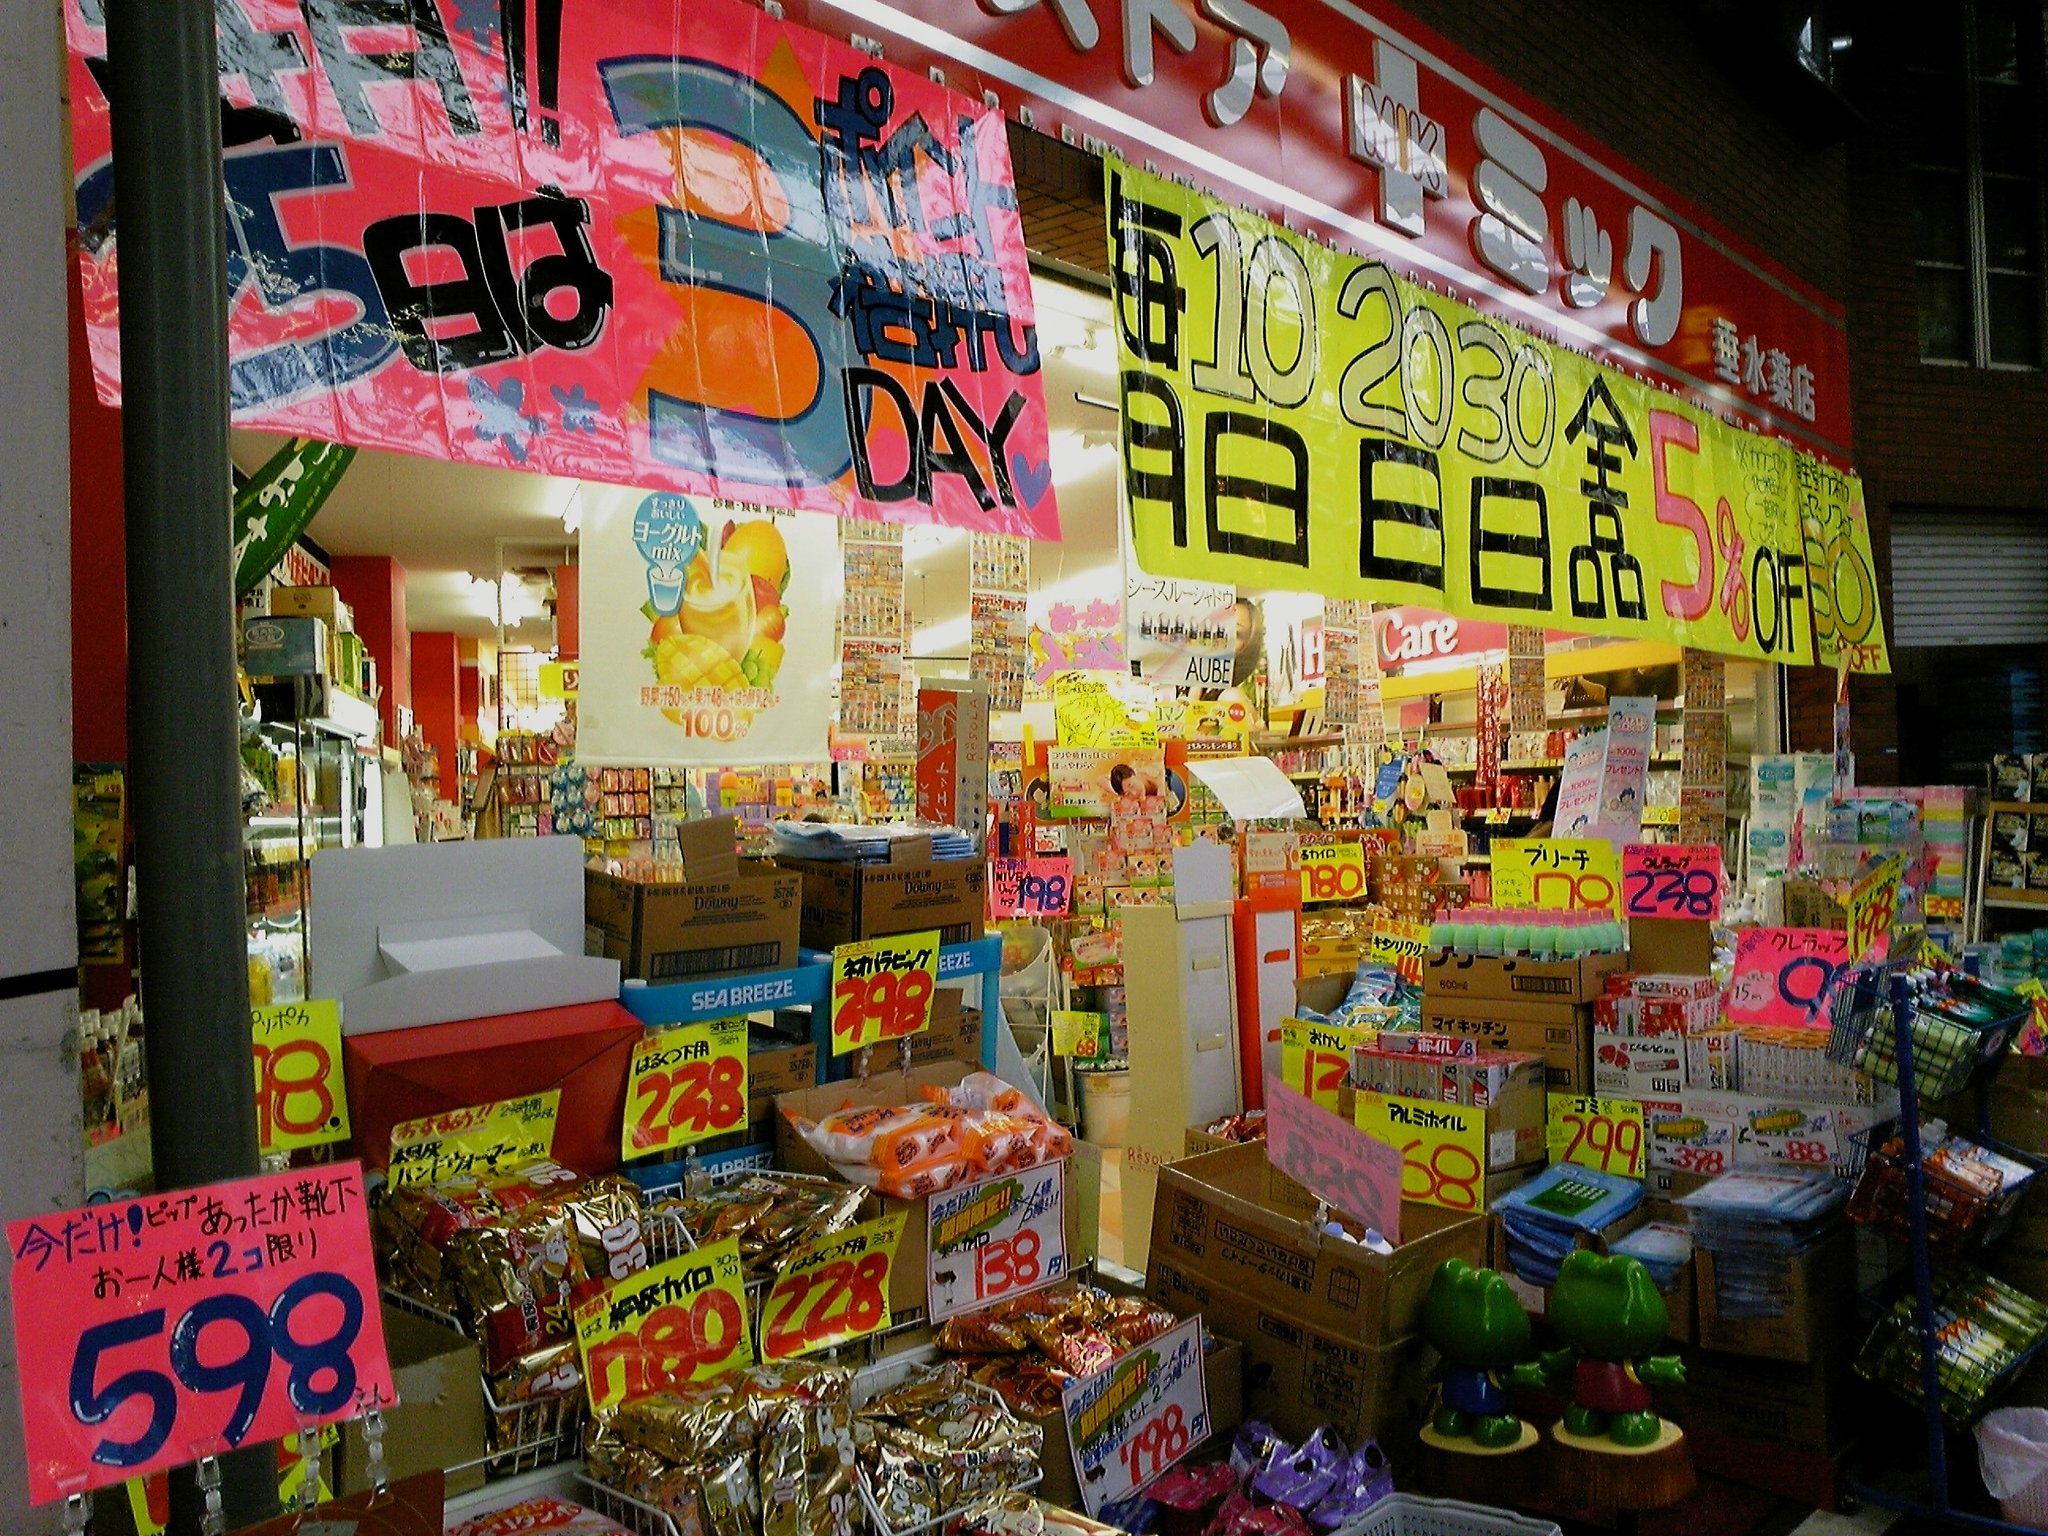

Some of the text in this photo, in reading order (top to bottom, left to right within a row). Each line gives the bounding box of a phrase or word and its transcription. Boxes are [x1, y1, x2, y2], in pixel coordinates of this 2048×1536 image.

[1472, 106, 1683, 347] ミック
[1110, 168, 1190, 550] 毎月
[1712, 316, 1816, 423] 垂水薬店
[841, 366, 1026, 513] DAY
[1564, 374, 1649, 621] 全品
[632, 521, 703, 547] ヨーグルト
[651, 544, 684, 561] mix
[1127, 580, 1236, 611] シースルーシャドウ
[1379, 613, 1461, 663] Care
[1186, 655, 1232, 685] AUBE
[680, 707, 749, 740] 100%
[1523, 844, 1591, 871] ブリーチ
[693, 894, 739, 911] Downy
[903, 880, 942, 896] Downy
[1432, 1016, 1508, 1036] マイキッチン
[1464, 1041, 1473, 1056] 8
[1387, 1102, 1468, 1132] アルミホイル
[1563, 1114, 1641, 1178] 299
[16, 1176, 357, 1273] 今だけ! ピップ あったか靴下
[764, 1251, 890, 1360] 228
[69, 1271, 364, 1468] 598
